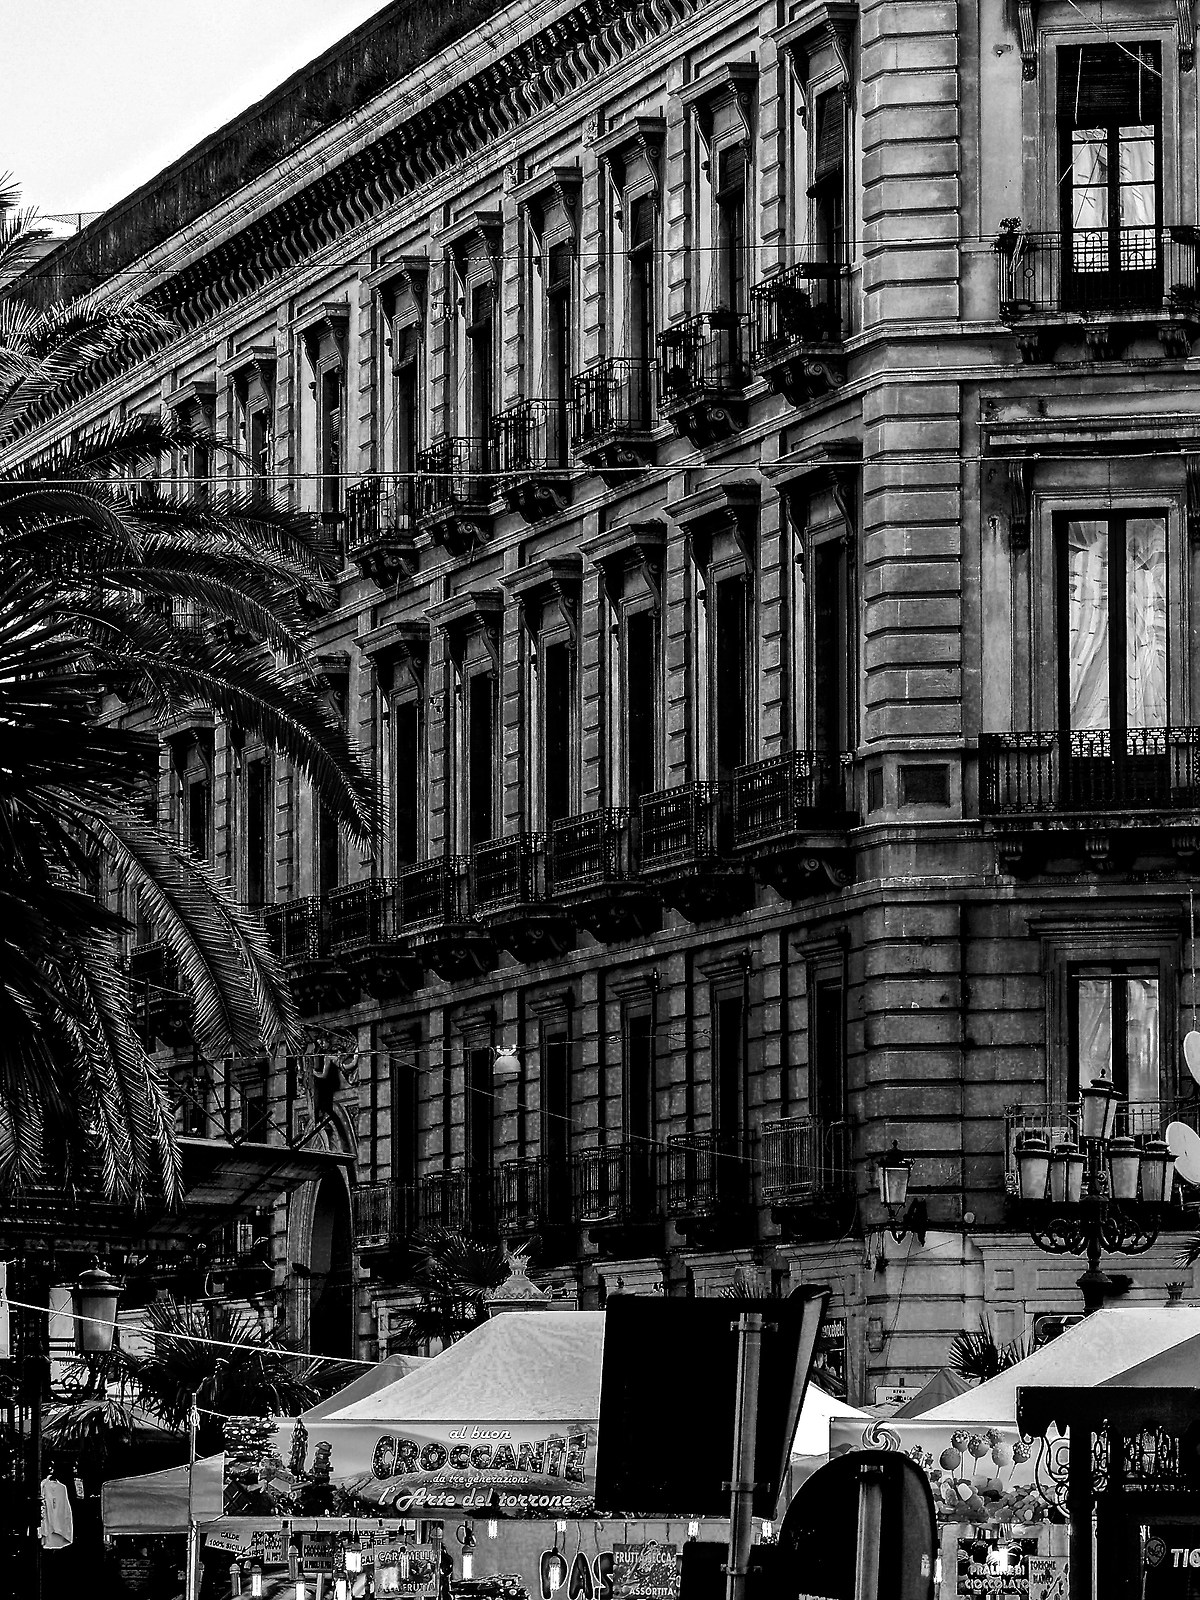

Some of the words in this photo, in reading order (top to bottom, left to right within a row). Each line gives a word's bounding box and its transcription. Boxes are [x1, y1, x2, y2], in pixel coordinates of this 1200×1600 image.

[449, 1426, 466, 1439] al
[470, 1426, 512, 1439] buon
[371, 1433, 588, 1483] CROCCANTE
[466, 1475, 530, 1488] generazioni
[462, 1488, 492, 1506] del
[498, 1492, 573, 1507] torrone
[965, 1578, 1030, 1590] CIOCCOLATO
[629, 1586, 674, 1596] ASSORTITA
